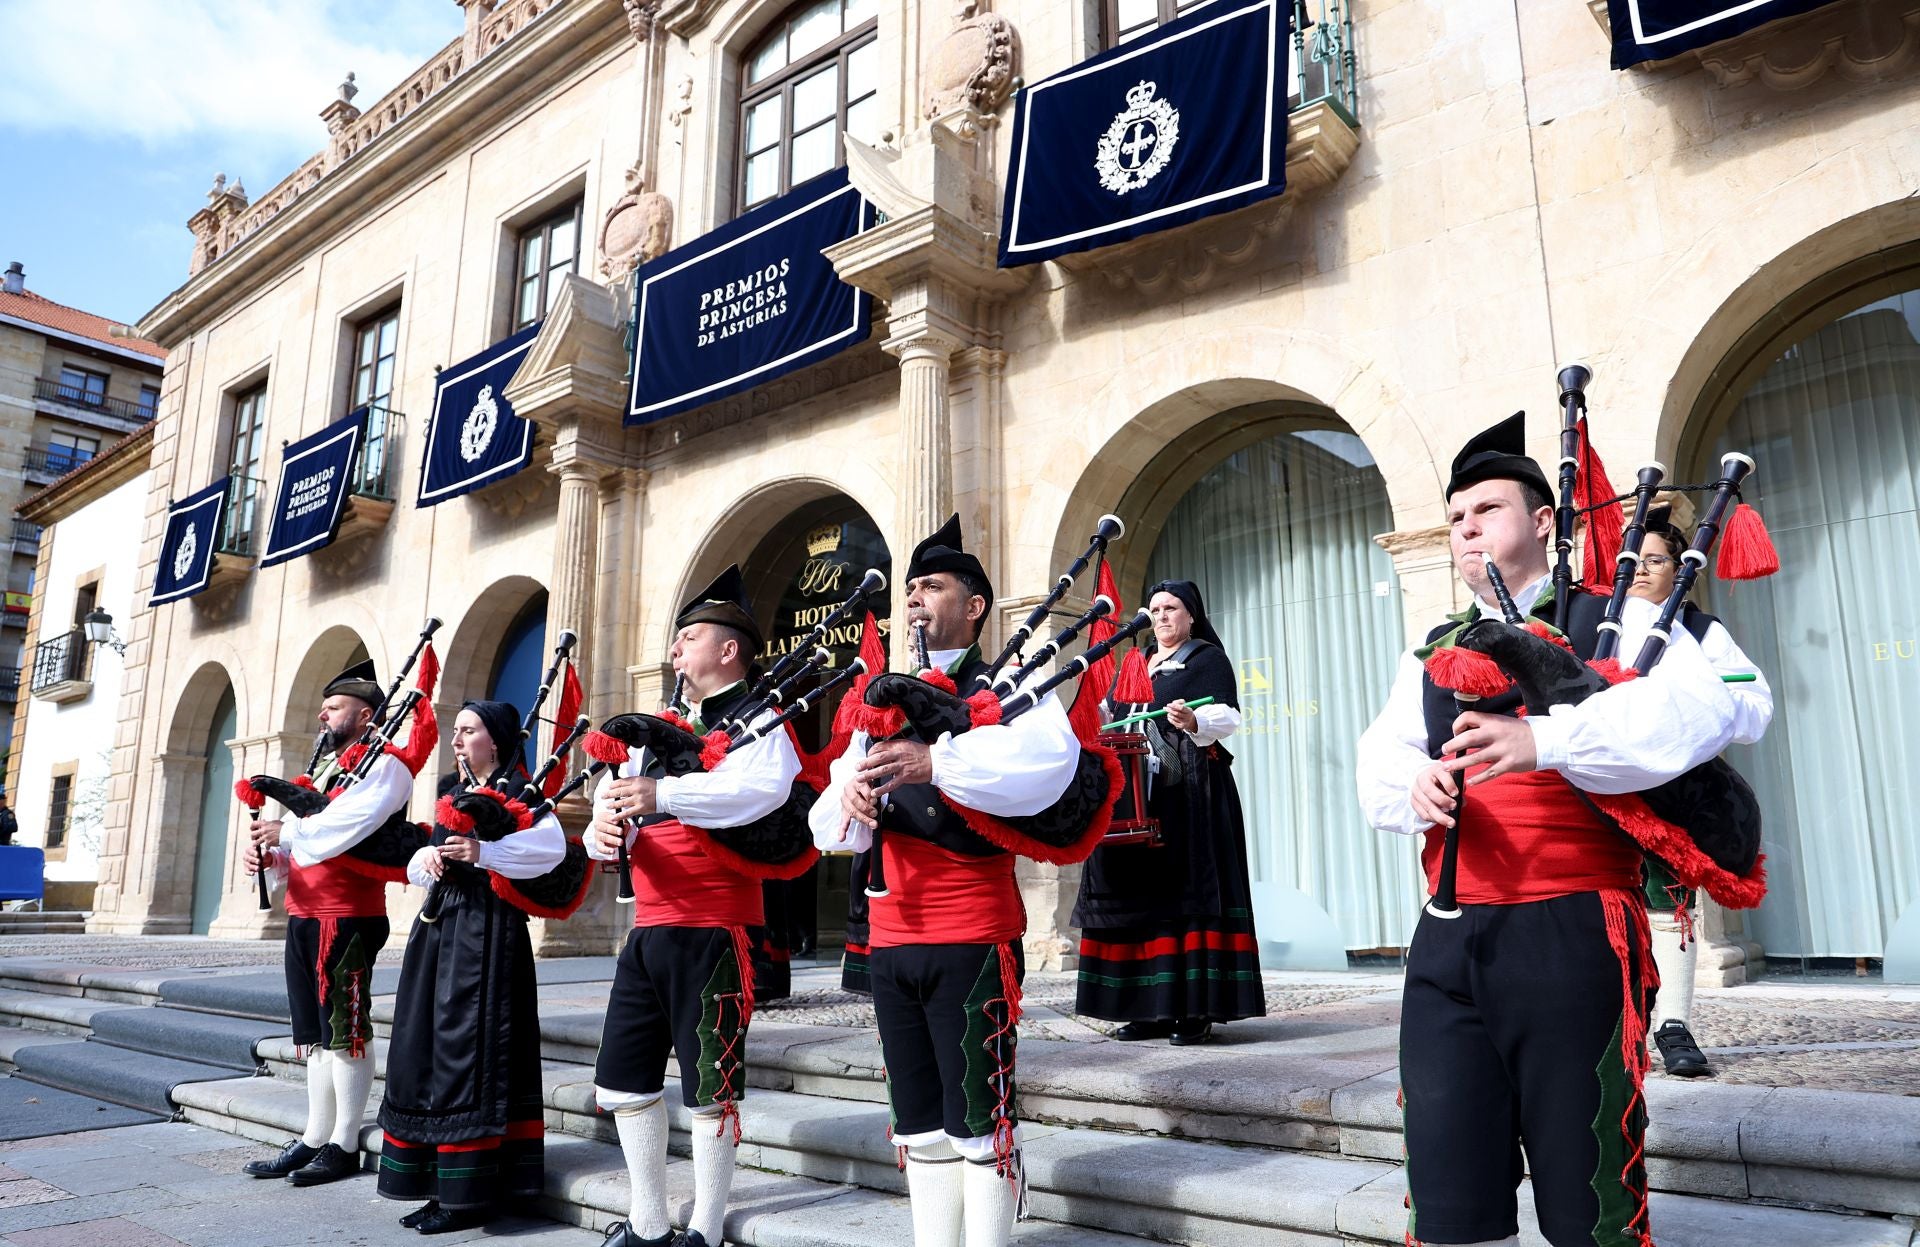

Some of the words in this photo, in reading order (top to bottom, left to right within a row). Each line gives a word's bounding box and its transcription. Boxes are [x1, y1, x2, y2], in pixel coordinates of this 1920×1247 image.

[699, 257, 790, 311] PREMIOS
[697, 331, 716, 348] DE
[720, 300, 787, 340] ASTURIAS
[698, 280, 788, 331] PRINCESA
[288, 481, 331, 509] PRINCESA
[291, 465, 336, 495] PREMIOS
[766, 638, 787, 657] LA
